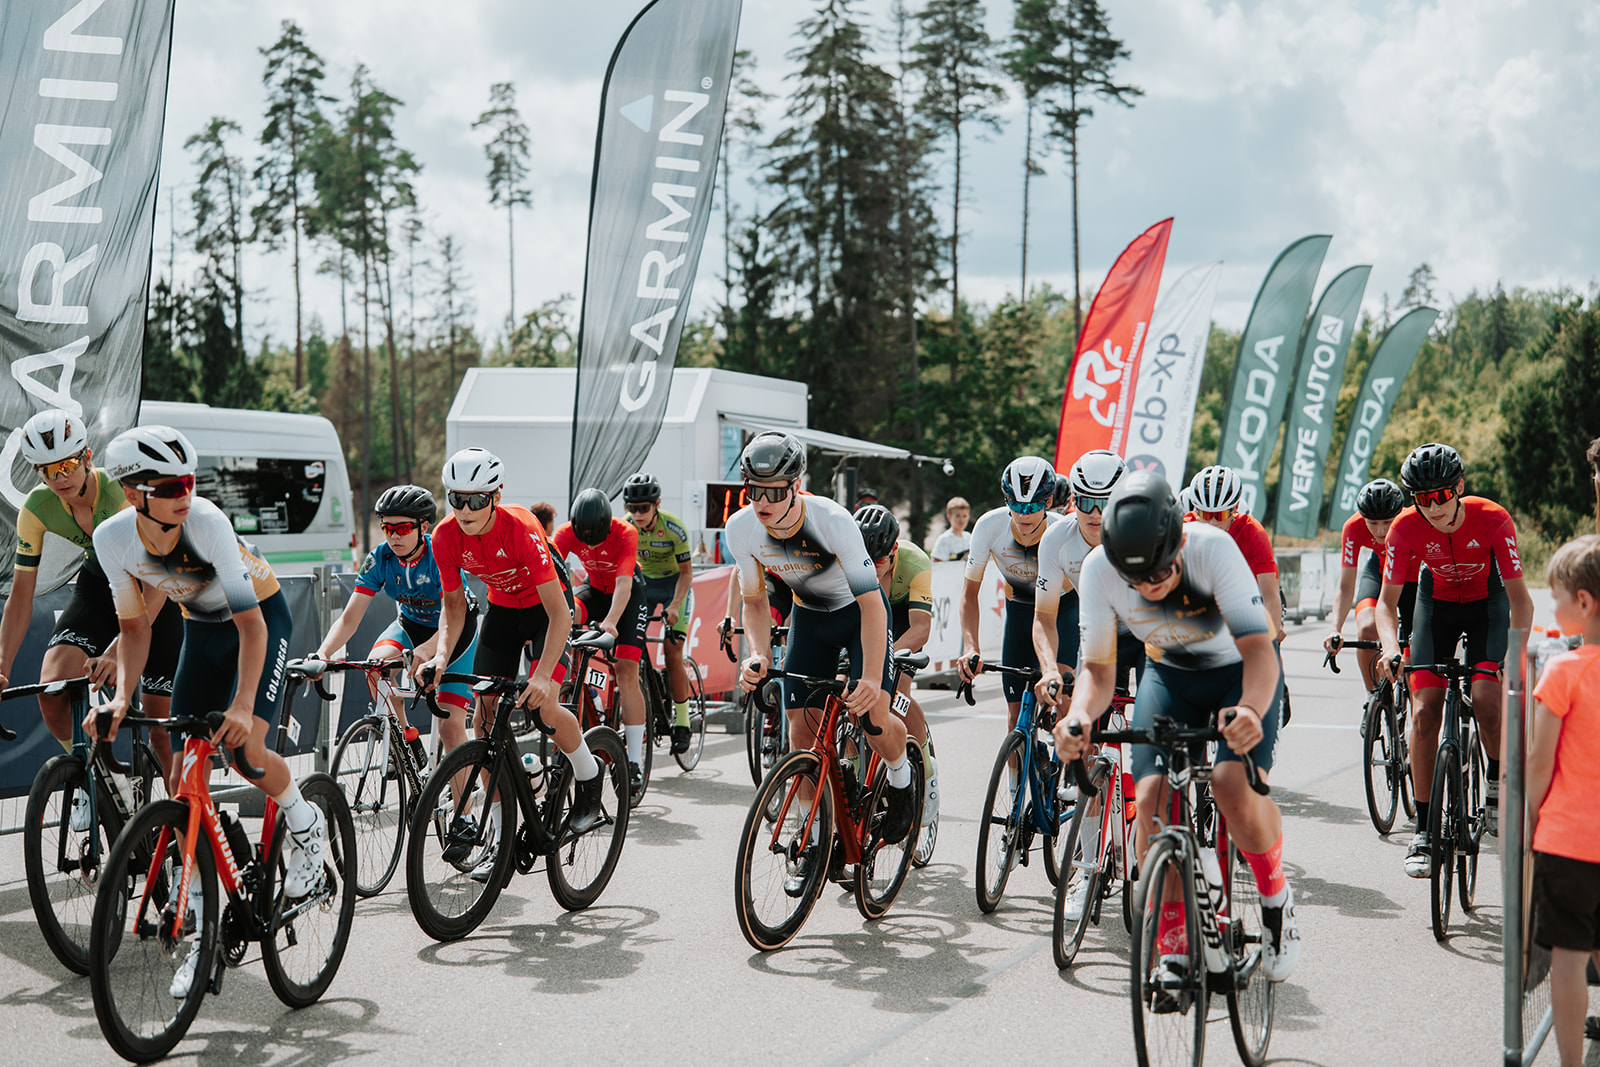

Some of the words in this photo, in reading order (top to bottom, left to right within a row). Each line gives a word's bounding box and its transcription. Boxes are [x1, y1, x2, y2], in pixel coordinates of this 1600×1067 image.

[619, 89, 710, 412] GARMIN
[1134, 333, 1185, 444] cb-xp
[1303, 345, 1336, 425] AUTO
[1289, 426, 1319, 512] VERTE
[529, 531, 549, 566] ZZK
[1344, 536, 1355, 565] ZZK
[1384, 541, 1395, 580] ZZK
[1505, 535, 1522, 571] ZZK
[636, 604, 648, 633] RRS
[266, 637, 288, 703] GOLDINGEN
[588, 671, 606, 687] 117
[896, 695, 909, 713] 118
[205, 800, 248, 901] S-WORKS
